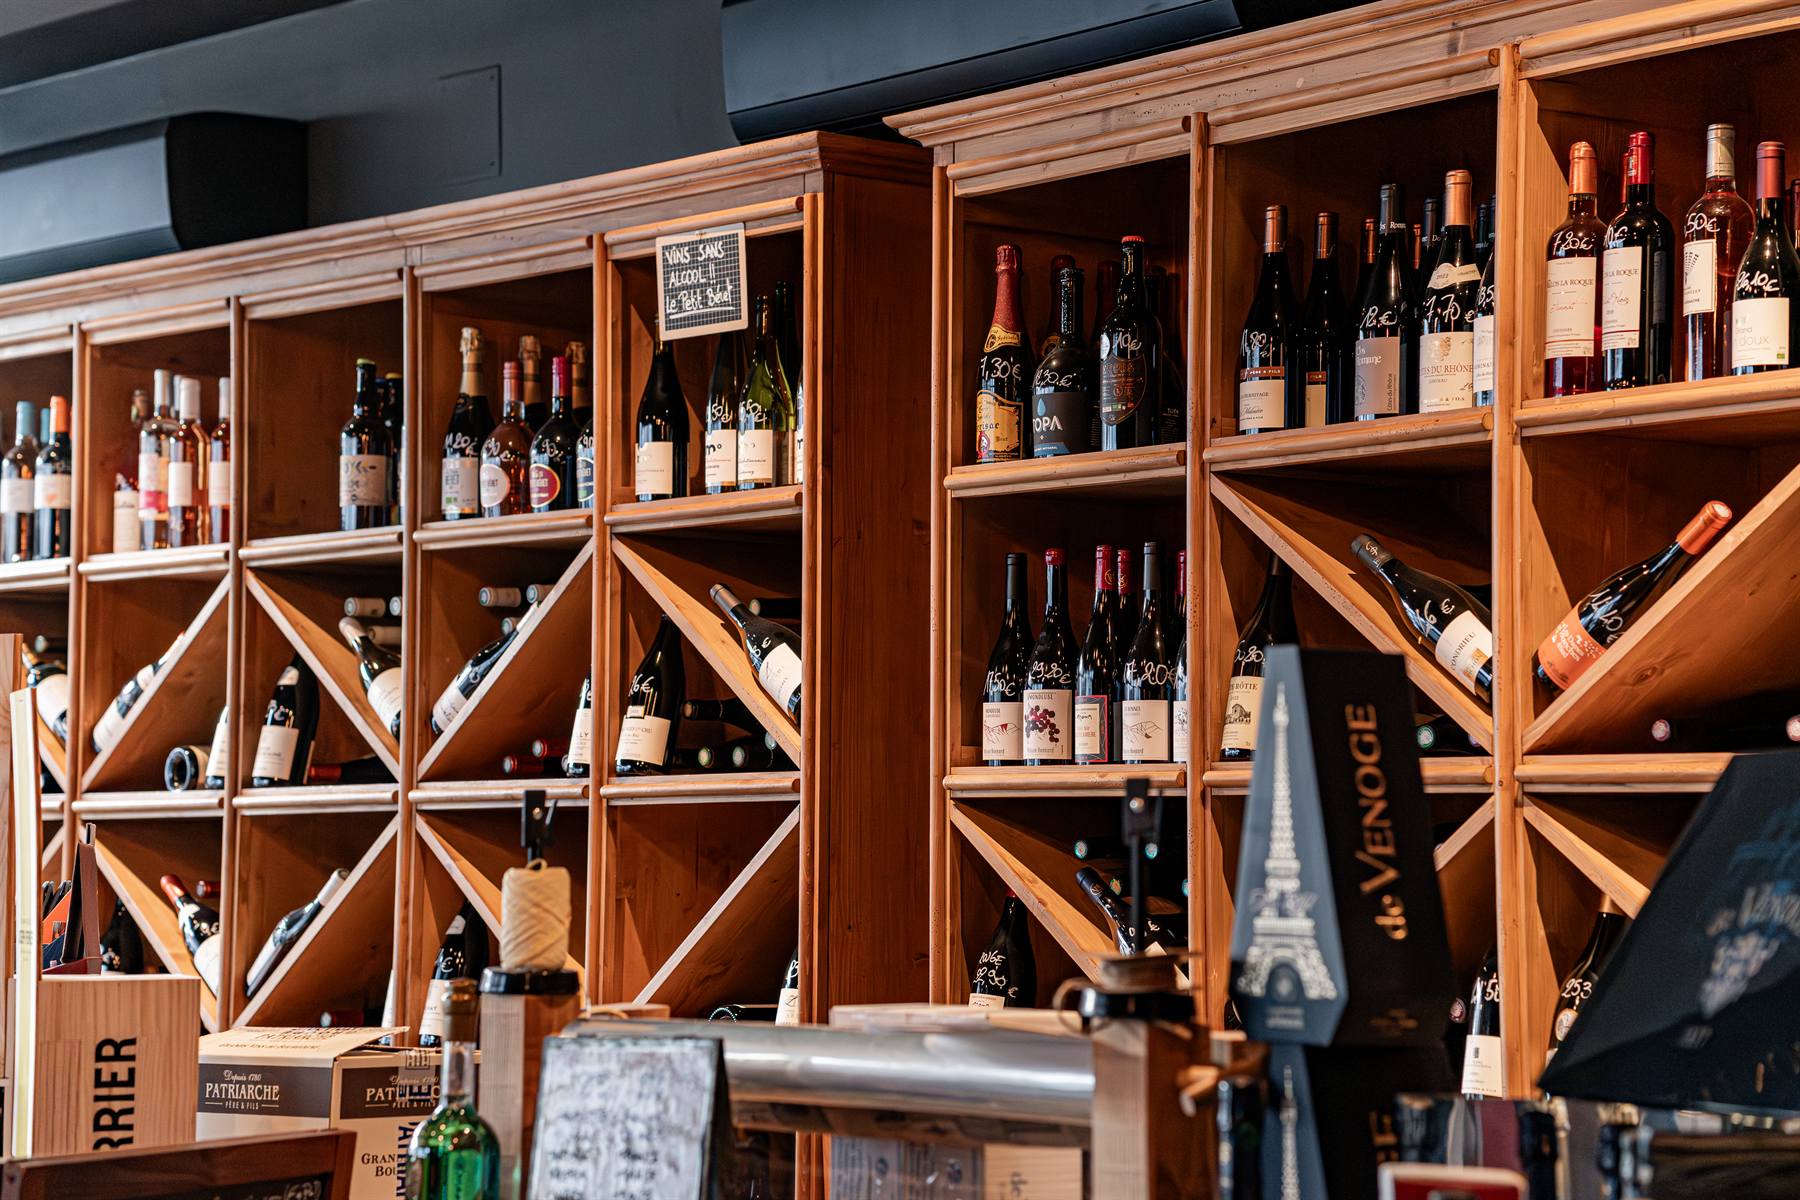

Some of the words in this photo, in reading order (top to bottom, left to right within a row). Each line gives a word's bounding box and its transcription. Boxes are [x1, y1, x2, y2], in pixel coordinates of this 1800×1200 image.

[697, 241, 725, 261] SANS
[668, 266, 706, 288] ALCOOL
[678, 289, 703, 310] Petit
[1432, 365, 1443, 374] DU
[1344, 703, 1401, 896] VENOGE
[223, 1069, 247, 1081] Depuis
[248, 1072, 262, 1082] 1780
[205, 1082, 280, 1101] PATRIARCHE
